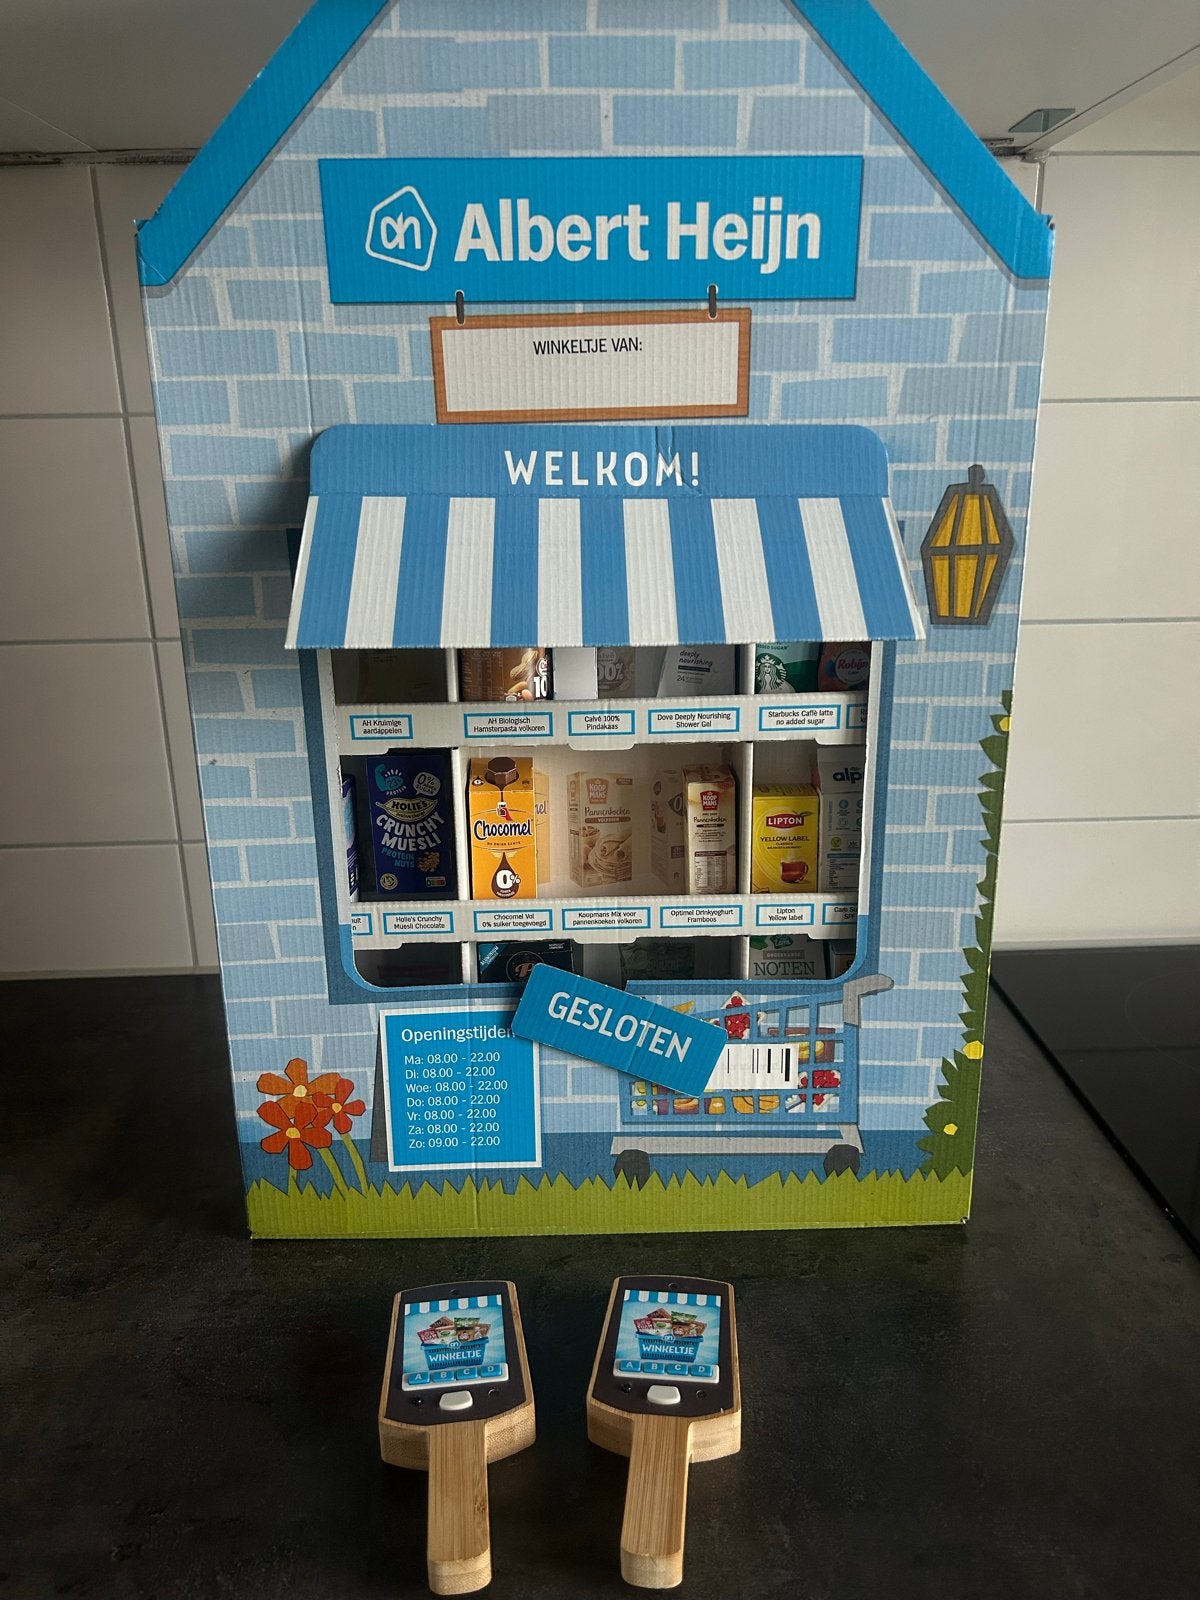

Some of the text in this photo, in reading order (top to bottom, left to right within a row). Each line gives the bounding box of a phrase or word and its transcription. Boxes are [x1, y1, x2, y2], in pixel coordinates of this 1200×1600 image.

[454, 196, 821, 275] Albert Heijn
[533, 337, 643, 356] WINKELTJE VAN:
[504, 450, 699, 487] WELKOM!
[679, 650, 701, 658] deeply
[678, 657, 713, 667] nourishing
[657, 711, 731, 722] Dove Deeply Nourishing
[768, 710, 800, 718] Starbucks
[818, 709, 834, 717] latte
[362, 719, 402, 728] AH Kruimige
[499, 717, 531, 726] Biologisch
[584, 715, 602, 723] Calvé
[785, 717, 805, 725] added
[806, 717, 825, 727] sugar
[473, 724, 545, 733] Hamsterpasta volkoren
[586, 722, 618, 731] Pindakaas
[676, 720, 712, 729] Shower Gel
[363, 726, 403, 735] aardappelen
[375, 811, 446, 838] CRUNCHY
[768, 816, 803, 825] LIPTON
[473, 819, 533, 840] Chocomel
[381, 832, 443, 852] MUESLI
[381, 847, 415, 861] PROTEIN
[394, 859, 416, 869] NUTS
[495, 869, 521, 889] 0%
[670, 909, 733, 918] Optimel Drinkyoghurt
[776, 907, 795, 915] Lipton
[395, 915, 442, 923] Holie's Crunchy
[493, 913, 523, 921] Chocomel
[573, 918, 615, 926] pannenkoeken
[788, 913, 803, 921] label
[415, 922, 445, 930] Chocolate
[493, 920, 511, 928] suiker
[512, 919, 547, 929] toegevoegd
[754, 960, 815, 977] NOTEN
[548, 990, 692, 1063] GESLOTEN
[405, 1055, 423, 1065] Ma:
[427, 1053, 458, 1064] 08.00
[470, 1052, 500, 1062] 22.00
[406, 1069, 419, 1079] Di:
[423, 1068, 453, 1078] 08.00
[466, 1066, 495, 1076] 22.00
[406, 1083, 431, 1093] Woe:
[435, 1081, 466, 1092] 08.00
[478, 1080, 507, 1090] 22.00
[407, 1098, 424, 1107] Do:
[428, 1096, 458, 1106] 08.00
[470, 1095, 500, 1105] 22.00
[407, 1111, 420, 1121] Vr:
[424, 1110, 454, 1120] 08.00
[467, 1109, 496, 1119] 22.00
[408, 1125, 424, 1134] Za:
[427, 1124, 458, 1134] 08.00
[470, 1123, 499, 1133] 22.00
[409, 1139, 425, 1148] Zo:
[428, 1137, 458, 1148] 09.00
[470, 1136, 500, 1146] 22.00
[642, 1344, 694, 1354] WINKELTJE
[429, 1350, 481, 1362] WINKELTJE
